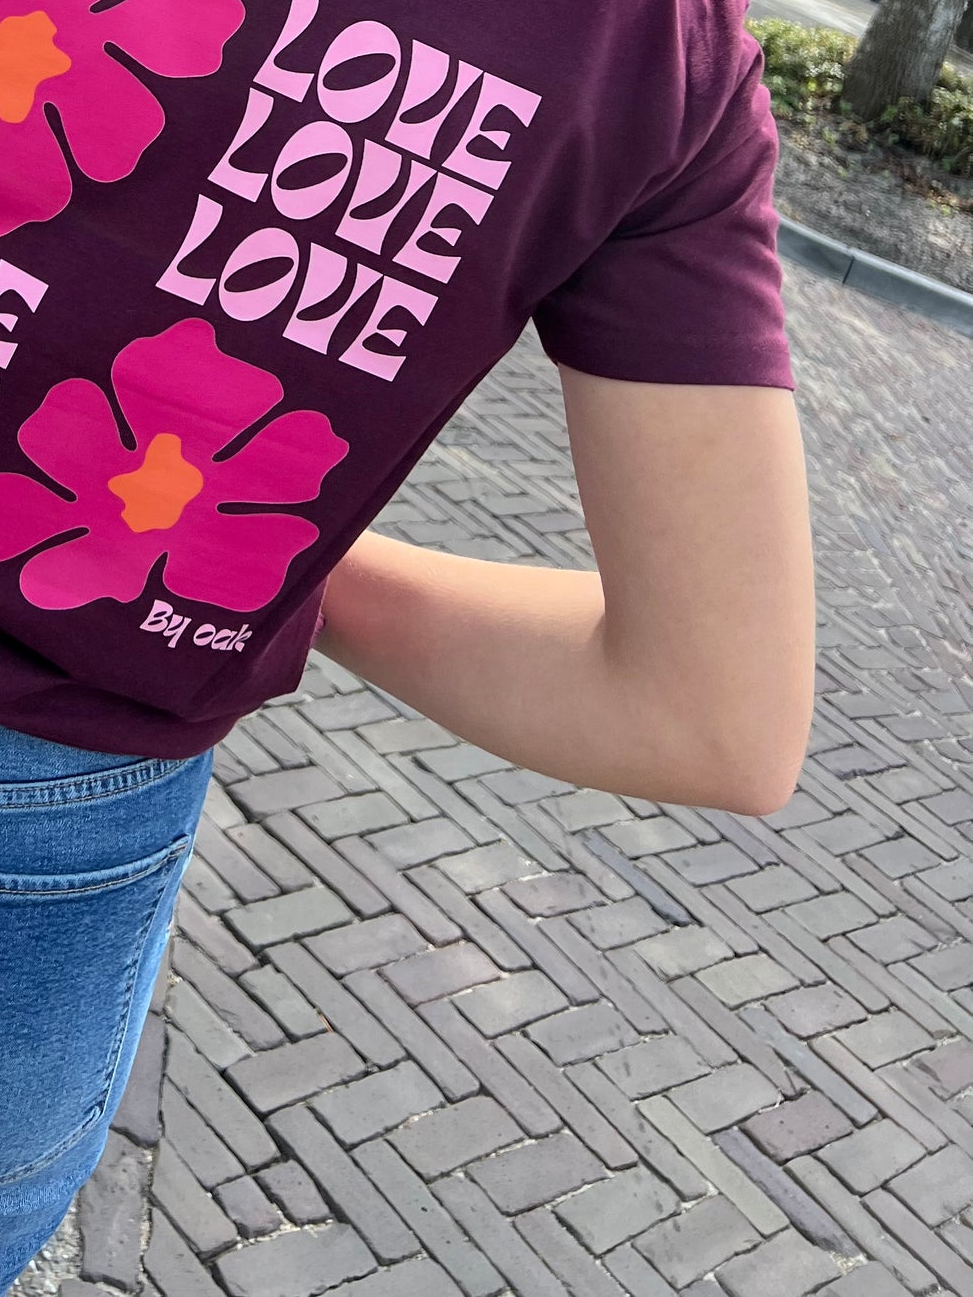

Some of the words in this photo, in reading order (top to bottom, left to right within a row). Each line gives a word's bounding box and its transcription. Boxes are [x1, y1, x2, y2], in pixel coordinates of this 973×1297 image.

[206, 87, 495, 284] LOVE
[155, 193, 439, 382] LOVE
[139, 599, 192, 649] By
